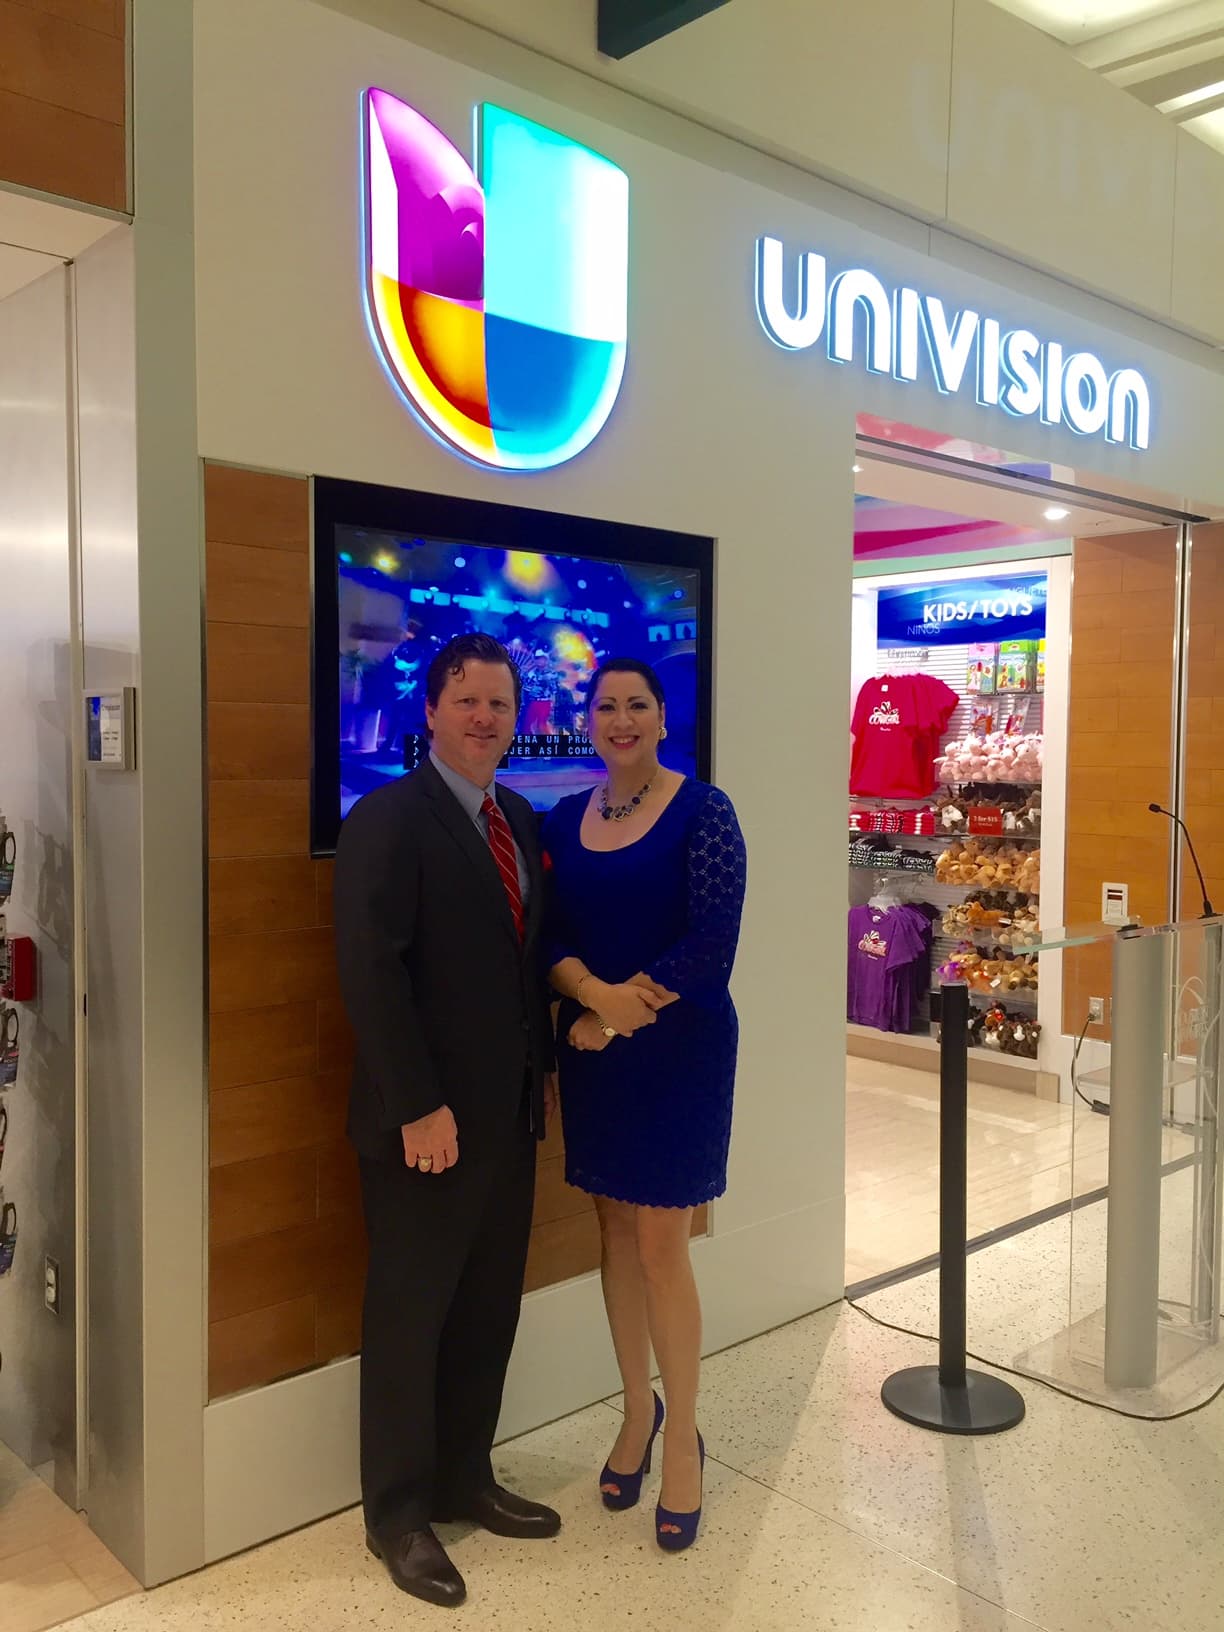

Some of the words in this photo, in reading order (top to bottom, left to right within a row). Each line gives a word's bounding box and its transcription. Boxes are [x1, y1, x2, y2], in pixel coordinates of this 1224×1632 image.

[923, 595, 1033, 623] KIDS/TOYS
[546, 735, 560, 744] UN
[538, 744, 558, 755] ASÍ
[567, 746, 594, 755] COMO
